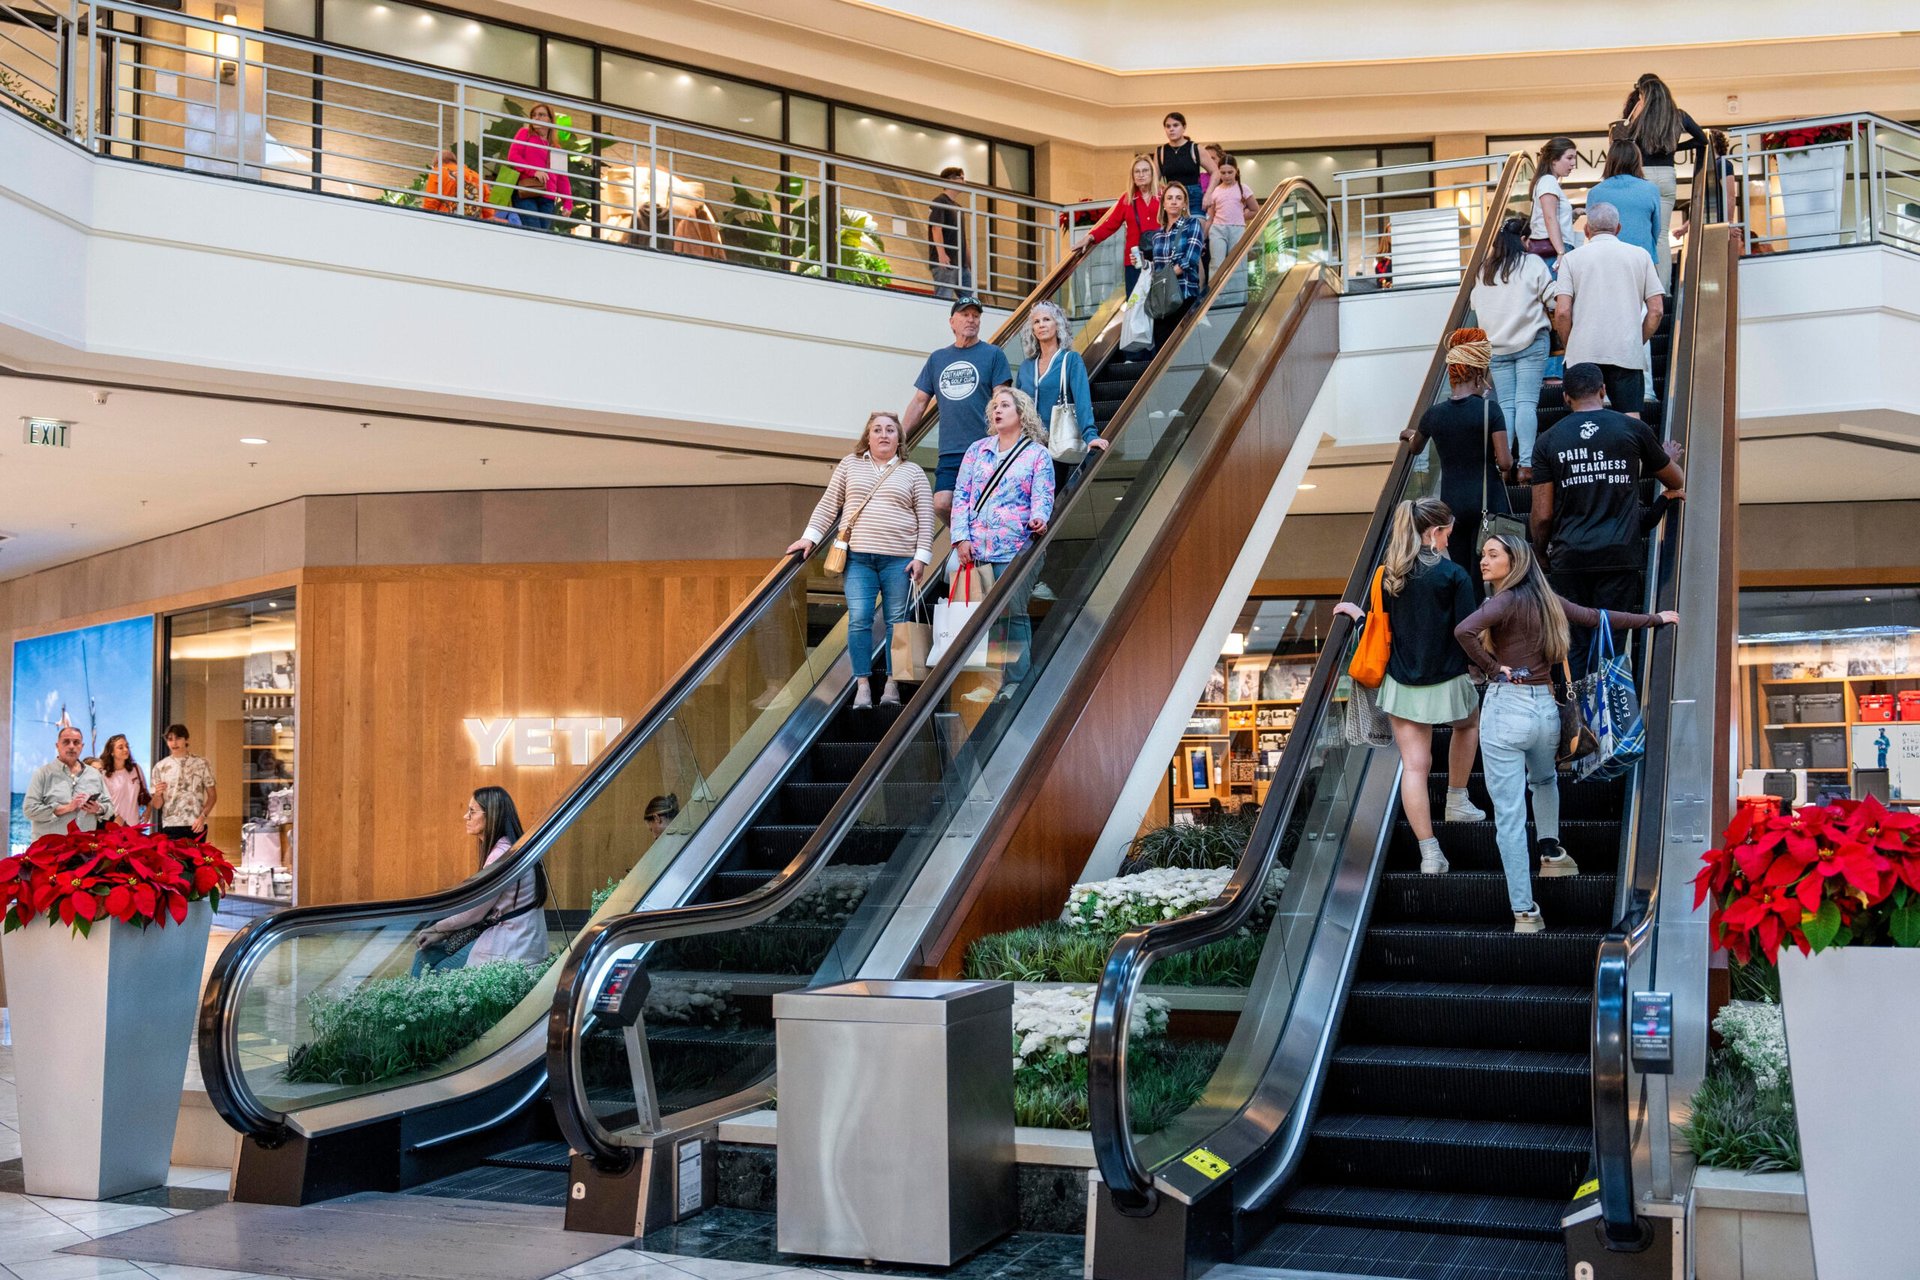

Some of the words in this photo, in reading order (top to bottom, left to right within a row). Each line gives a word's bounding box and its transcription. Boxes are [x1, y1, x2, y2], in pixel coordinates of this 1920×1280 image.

[30, 423, 67, 447] EXIT
[1557, 447, 1588, 464] PAIN
[1592, 450, 1604, 461] IS
[1571, 459, 1627, 474] WEAKNESS
[1561, 474, 1594, 488] LEAVING
[1595, 473, 1607, 481] THE
[1617, 684, 1631, 718] EAGLE
